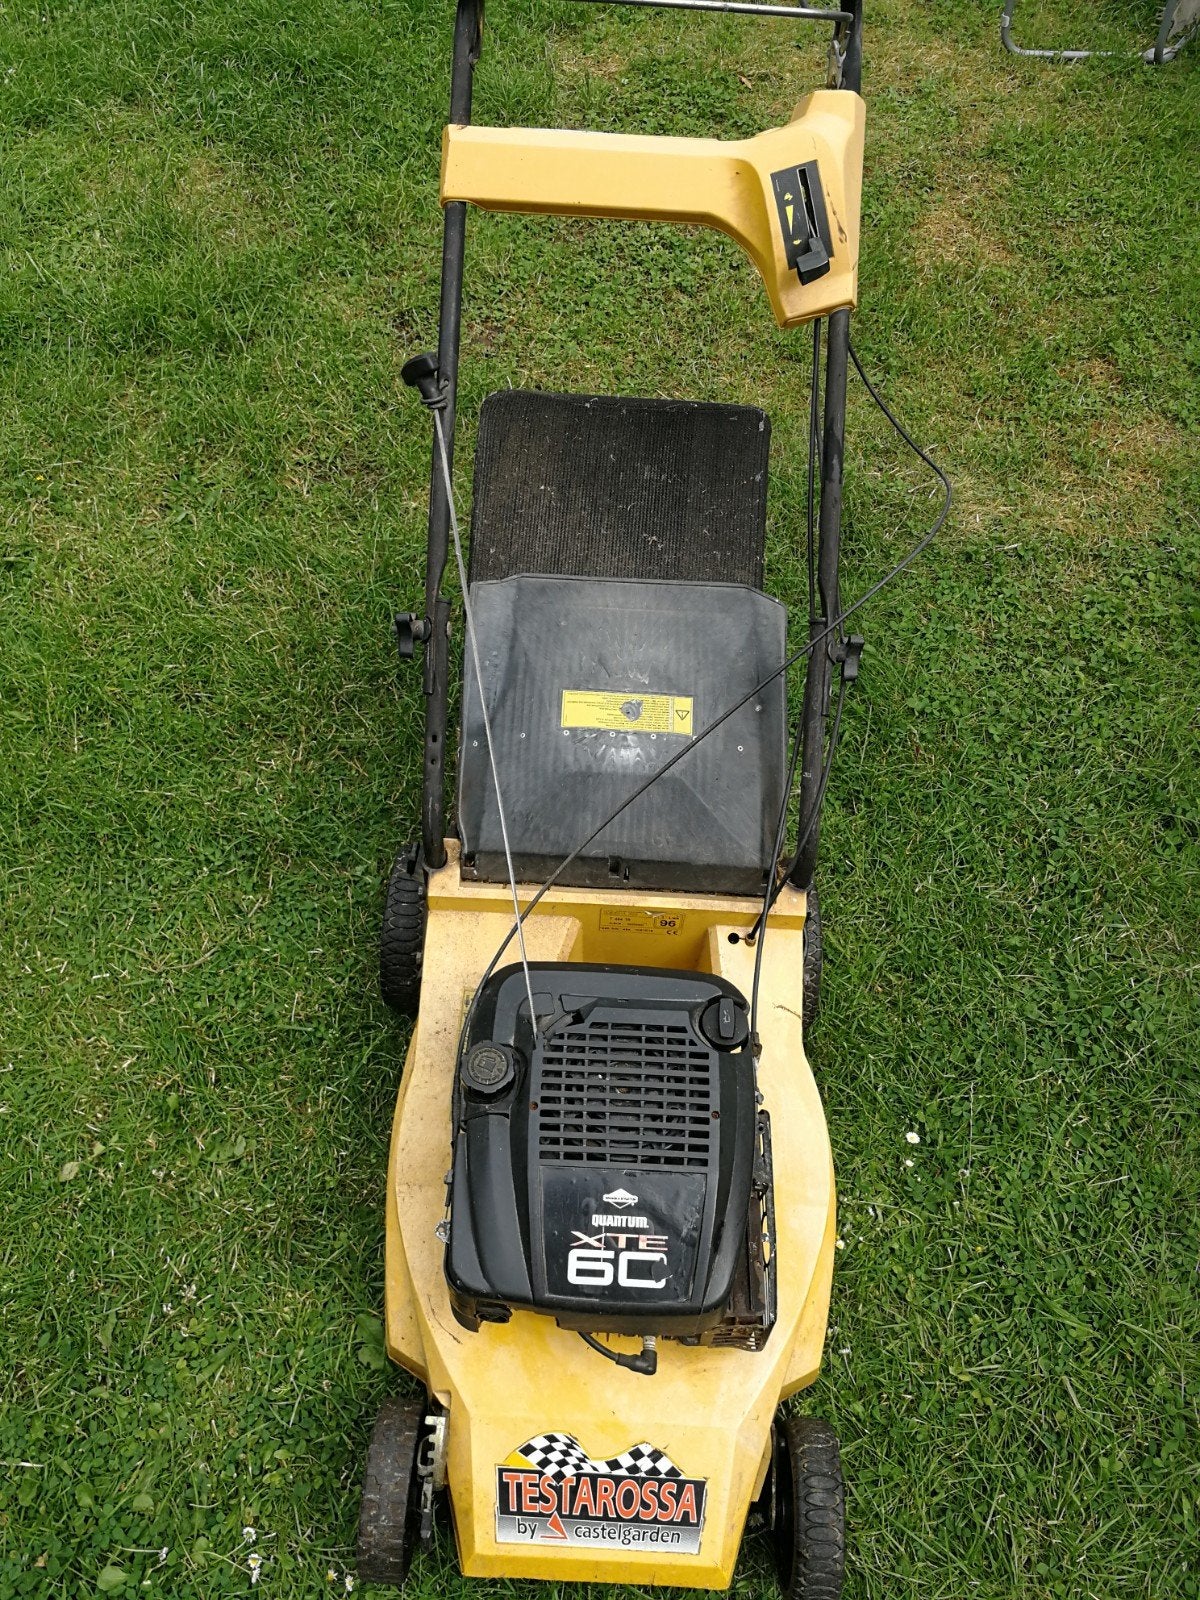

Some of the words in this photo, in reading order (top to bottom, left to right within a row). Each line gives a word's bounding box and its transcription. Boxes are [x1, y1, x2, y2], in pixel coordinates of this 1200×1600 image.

[660, 919, 676, 927] 96
[569, 1231, 669, 1251] XTE
[503, 1472, 697, 1523] TESTAROSSA
[516, 1518, 538, 1540] by
[574, 1522, 681, 1546] castelgarden
